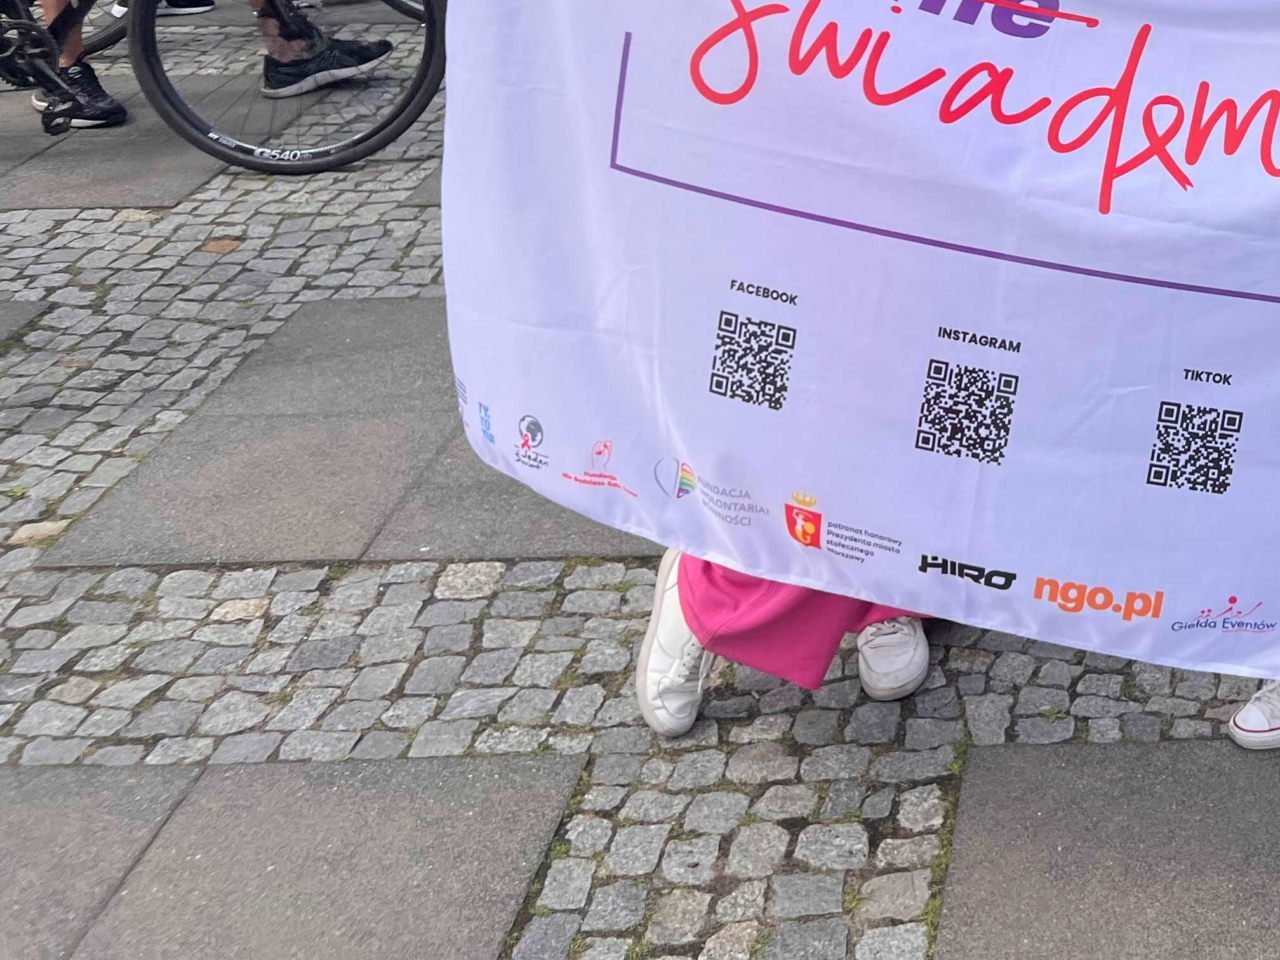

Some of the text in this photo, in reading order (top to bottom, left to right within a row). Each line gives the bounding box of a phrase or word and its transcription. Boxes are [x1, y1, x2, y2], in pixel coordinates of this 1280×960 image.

[730, 279, 798, 306] FACEBOOK
[937, 326, 1022, 354] INSTAGRAM
[1183, 367, 1233, 386] TIKTOK
[697, 475, 751, 500] FUNDACJA
[827, 521, 903, 547] patronat honorowy
[827, 529, 901, 554] Prezydenta miasta
[826, 539, 875, 556] stołecznego
[918, 554, 1017, 591] HIRO
[1033, 576, 1164, 621] ngo.pl
[1171, 617, 1277, 632] Giełda Eventów
